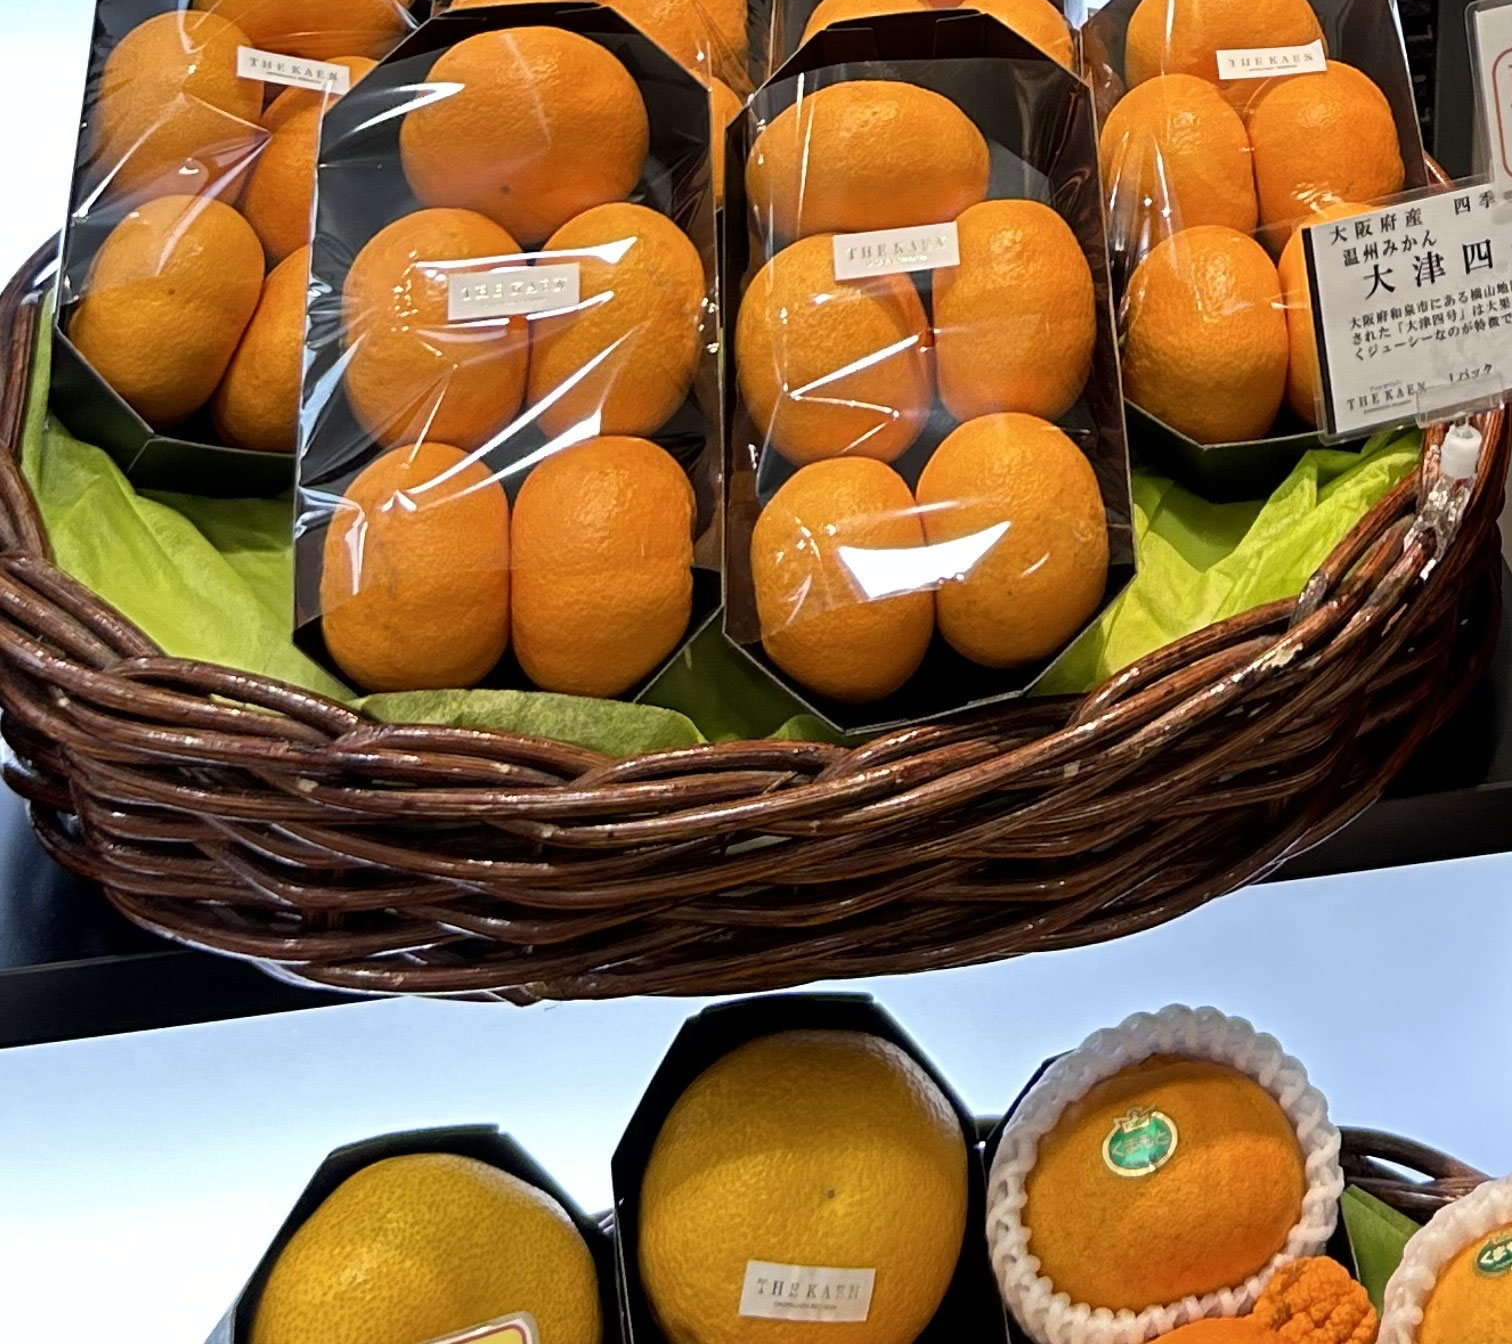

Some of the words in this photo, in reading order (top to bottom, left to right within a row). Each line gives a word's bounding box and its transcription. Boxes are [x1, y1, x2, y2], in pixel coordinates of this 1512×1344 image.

[249, 57, 285, 71] THE
[292, 65, 338, 81] KAEN
[1329, 207, 1423, 245] 大阪府産
[1342, 230, 1437, 267] 温州みかん
[1347, 393, 1380, 411] THE
[1385, 381, 1429, 402] KAEN
